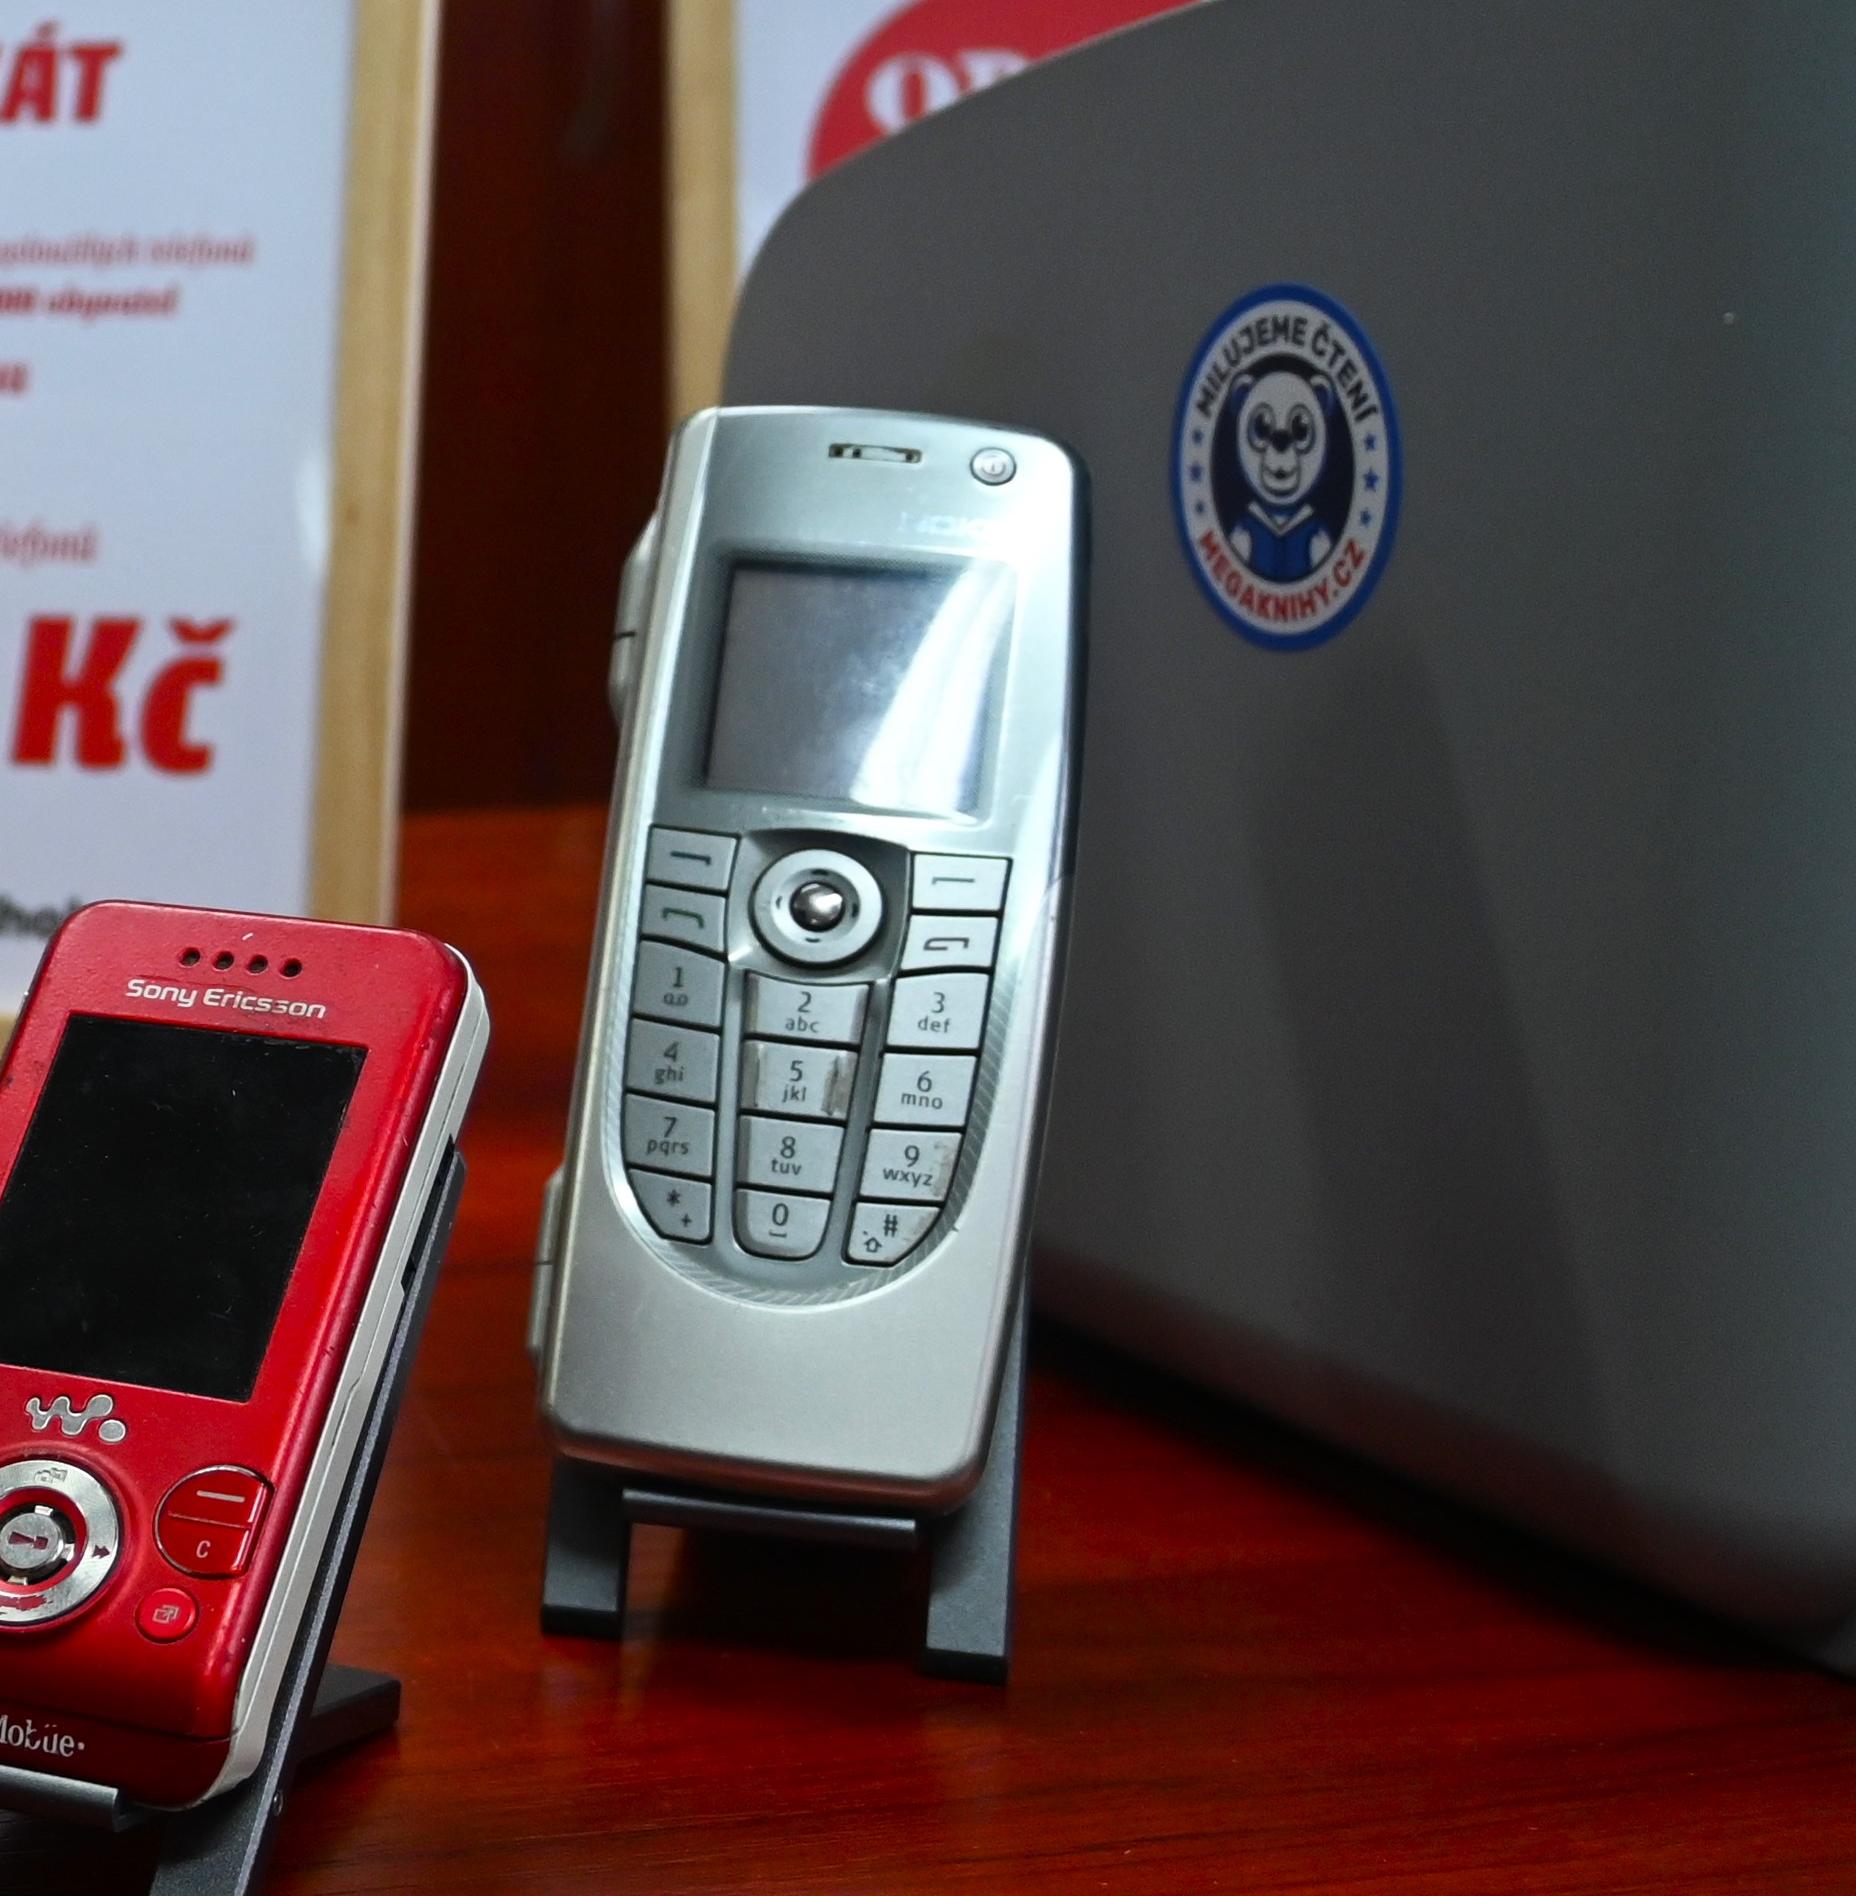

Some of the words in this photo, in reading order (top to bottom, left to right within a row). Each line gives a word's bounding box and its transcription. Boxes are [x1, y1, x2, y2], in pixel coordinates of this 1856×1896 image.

[1195, 314, 1309, 419] MILUJEME
[1310, 321, 1380, 424] ČTENÍ
[1197, 528, 1367, 624] MEGAKNIHY.CZ
[10, 613, 236, 776] Kč
[672, 966, 684, 989] 1
[125, 978, 198, 1008] Sony
[203, 988, 327, 1019] Ericsson
[798, 991, 813, 1014] 2
[931, 992, 946, 1014] 3
[784, 1016, 820, 1034] abc
[917, 1016, 951, 1034] def
[662, 1041, 680, 1063] 4
[654, 1065, 685, 1086] ghi
[789, 1059, 804, 1083] 5
[916, 1070, 933, 1093] 6
[781, 1084, 807, 1104] jkl
[901, 1091, 944, 1111] mno
[663, 1116, 678, 1138] 7
[646, 1137, 690, 1155] pqrs
[780, 1135, 797, 1160] 8
[904, 1145, 920, 1168] 9
[771, 1159, 803, 1177] tuv
[882, 1166, 934, 1188] wxyz
[771, 1202, 790, 1227] 0
[195, 1540, 212, 1560] C
